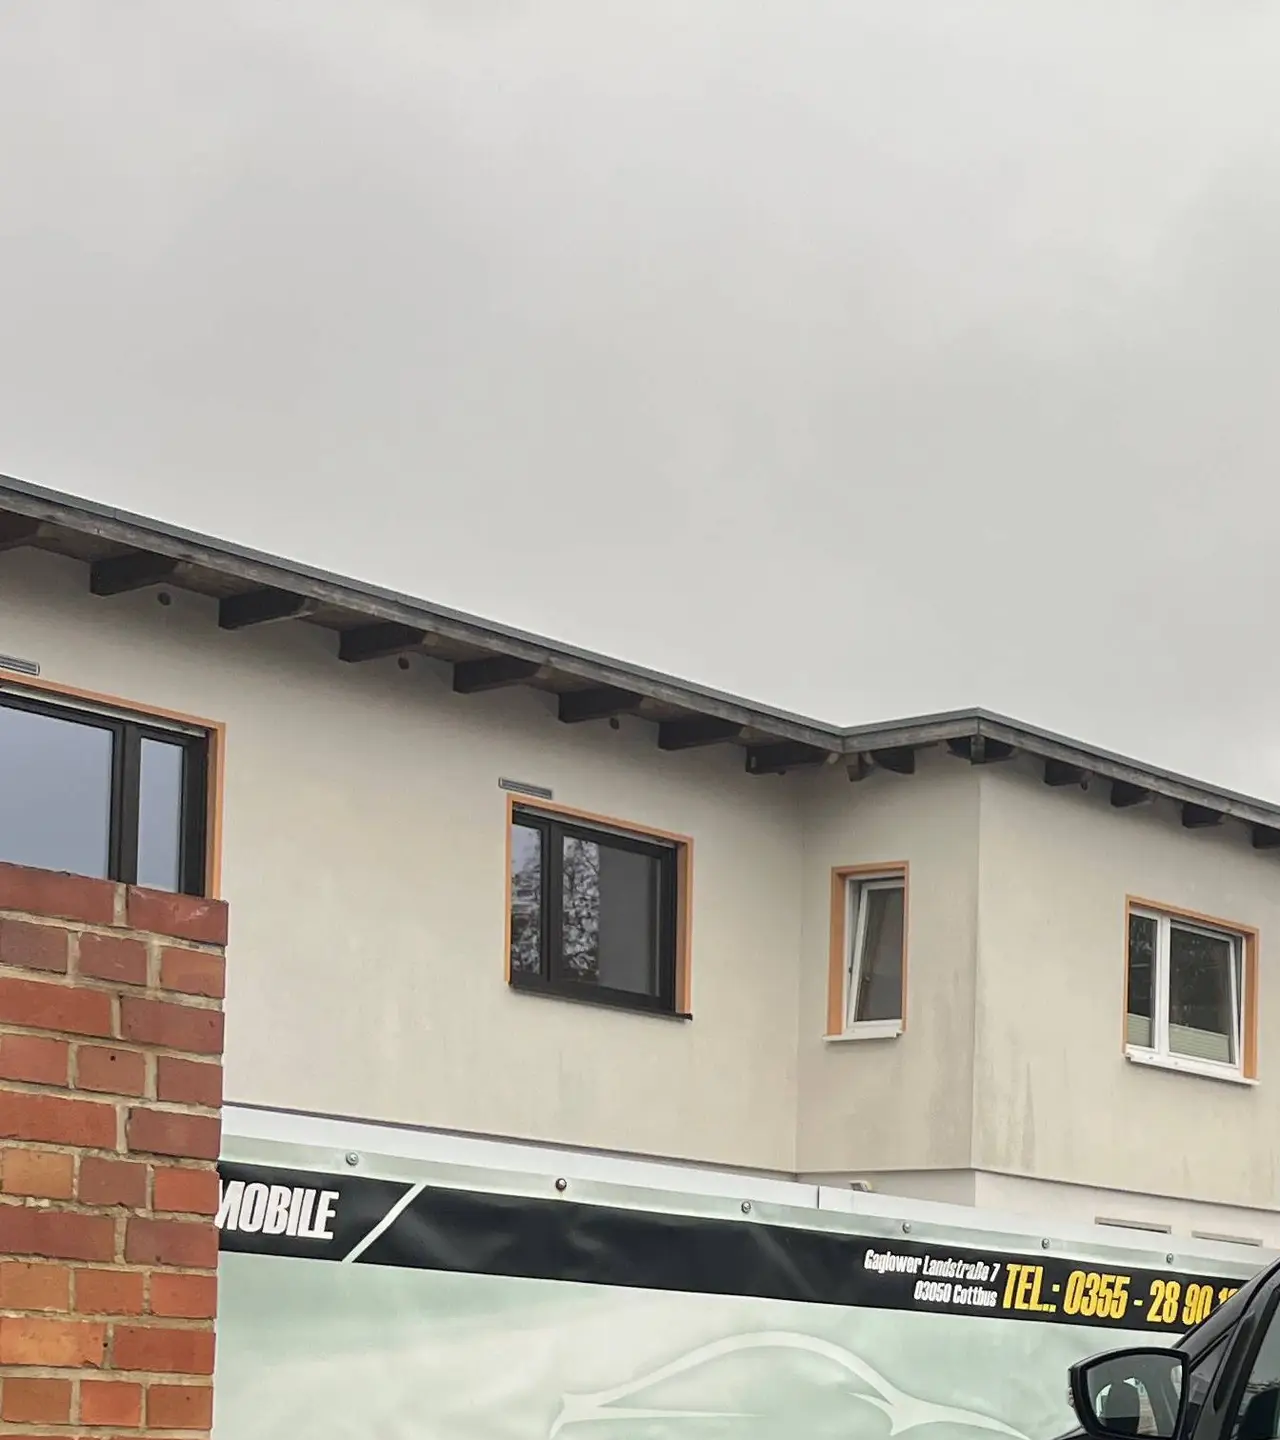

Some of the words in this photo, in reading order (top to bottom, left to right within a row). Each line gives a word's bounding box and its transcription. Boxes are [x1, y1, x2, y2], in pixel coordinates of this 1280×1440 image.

[863, 1249, 922, 1274] Gaglower
[922, 1255, 990, 1281] Landstraße
[989, 1262, 1001, 1283] 7
[913, 1280, 952, 1303] 03050
[952, 1284, 998, 1307] Cottbus
[1002, 1263, 1060, 1313] TEL.:
[1064, 1270, 1131, 1320] 0355
[1146, 1279, 1179, 1325] 28
[1182, 1283, 1213, 1325] 90
